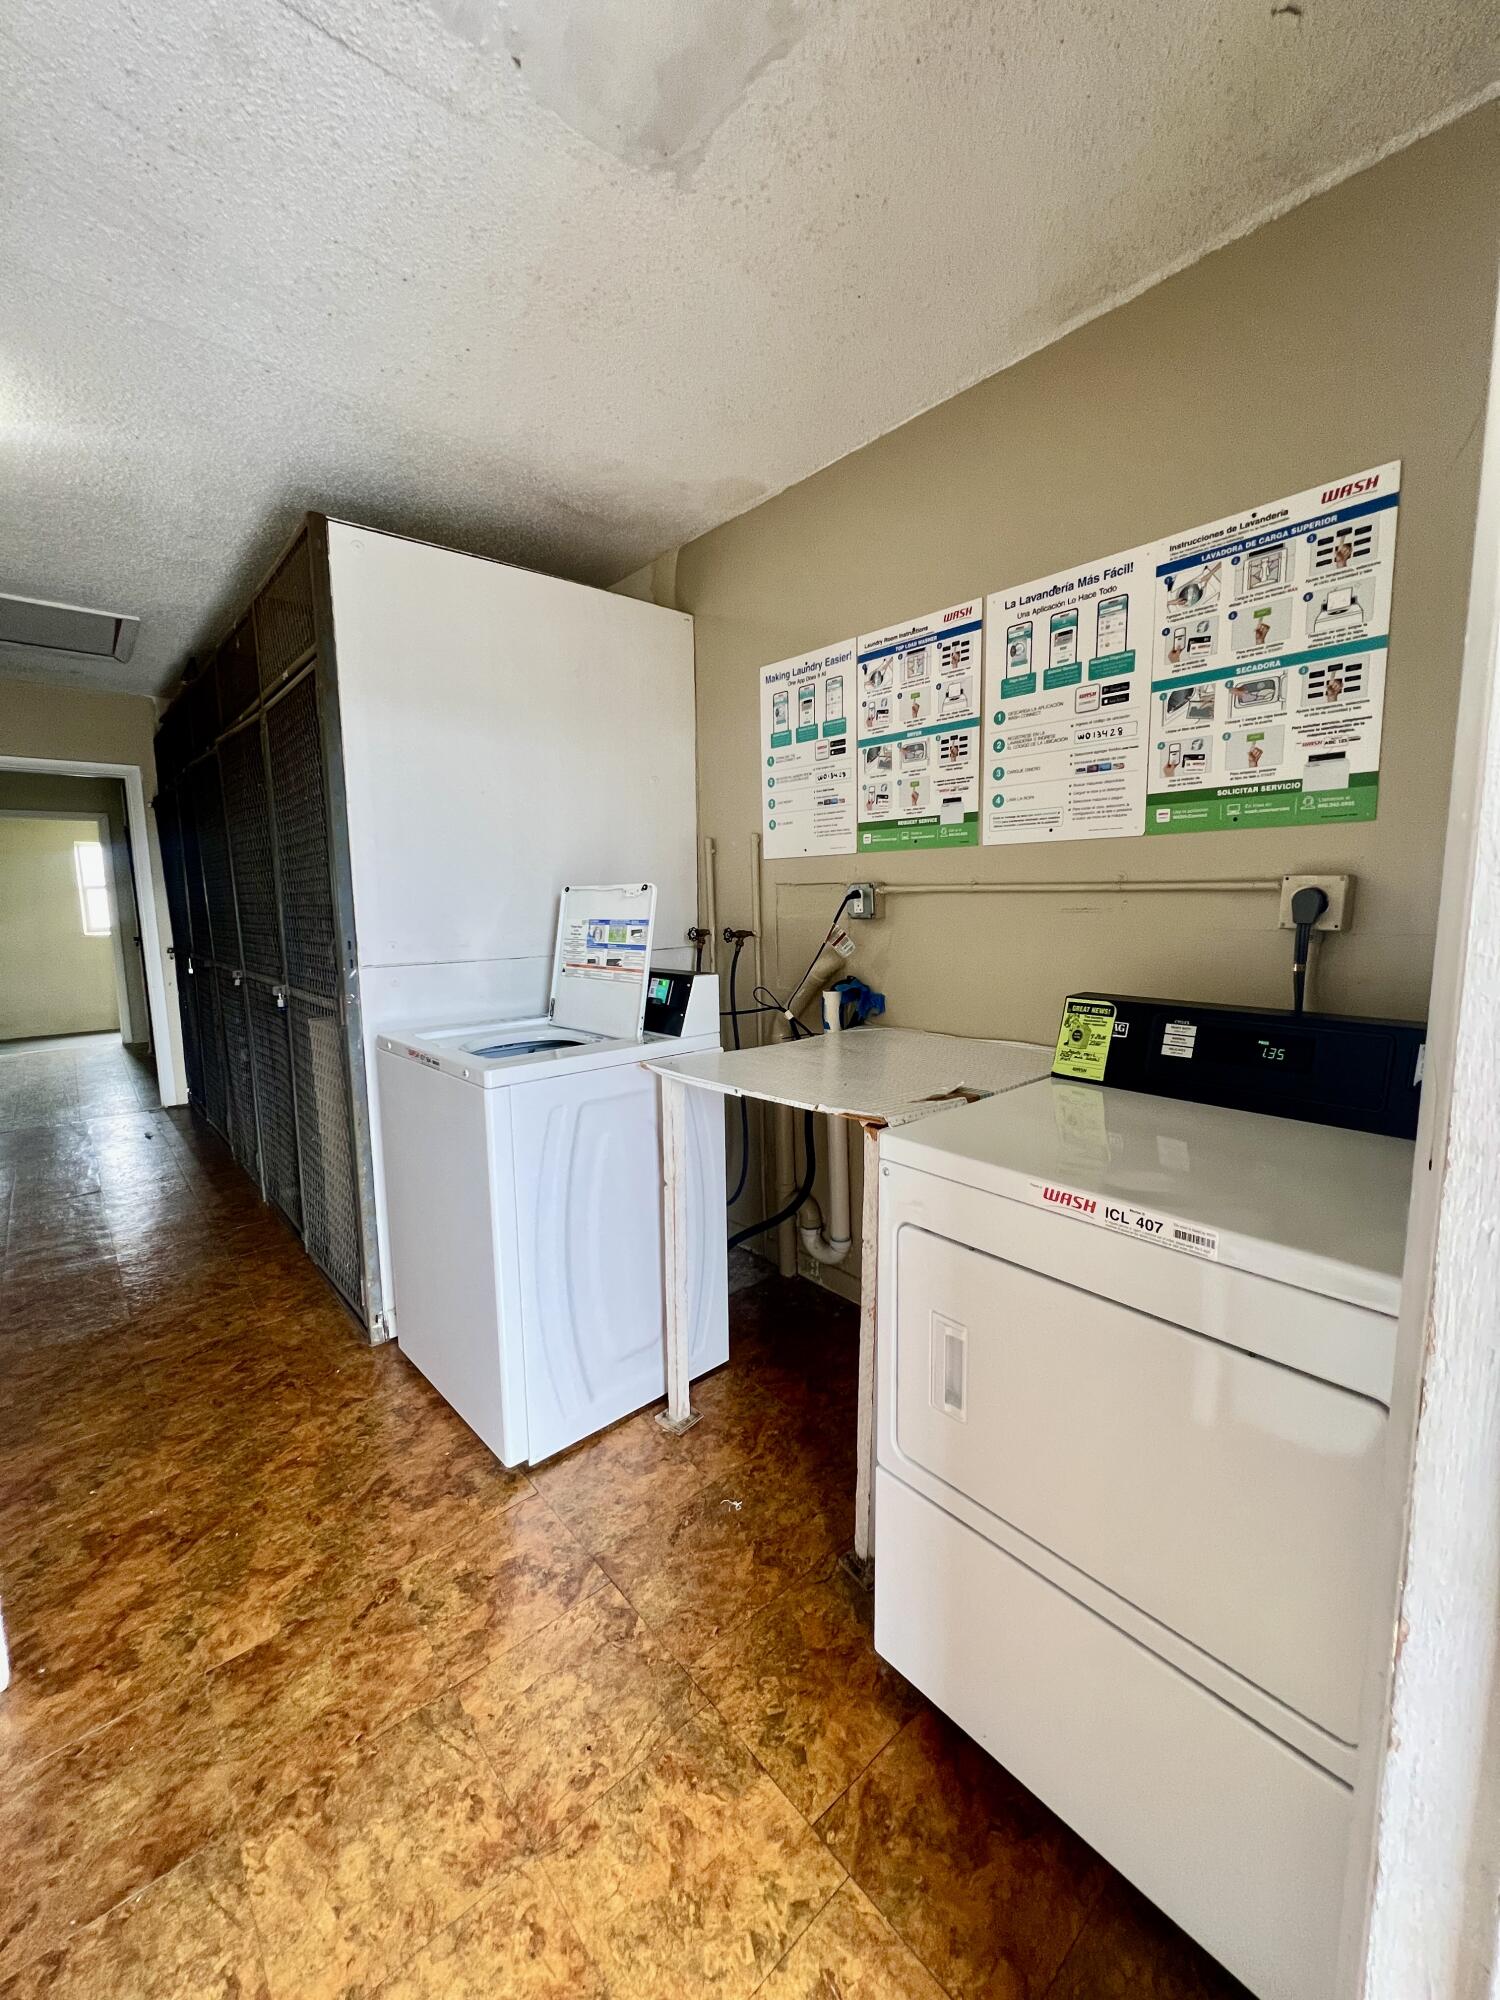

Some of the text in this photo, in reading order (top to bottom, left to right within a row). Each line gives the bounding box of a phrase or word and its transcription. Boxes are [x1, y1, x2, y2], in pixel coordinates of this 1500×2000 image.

[1321, 475, 1379, 504] WASH
[1169, 529, 1224, 552] Instrucciones
[1226, 525, 1237, 534] de
[1201, 545, 1243, 562] LAVADORA
[1245, 539, 1257, 549] DE
[1258, 530, 1289, 545] CARGA
[1291, 514, 1338, 535] SUPERIOR
[1004, 562, 1134, 610] La Lavandería Más Fácil!
[943, 606, 973, 623] WASH
[1016, 585, 1118, 620] Una Aplicación Lo Hace Todo
[864, 639, 883, 649] Laundry
[884, 635, 898, 643] Room
[765, 650, 852, 685] Making Laundry Easier!
[1236, 660, 1281, 675] SECADORA
[1216, 781, 1301, 797] SOLICITAR SERVICIO
[1071, 1005, 1091, 1013] GREAT
[1043, 1187, 1097, 1214] WASH
[1105, 1206, 1164, 1234] ICL 407
